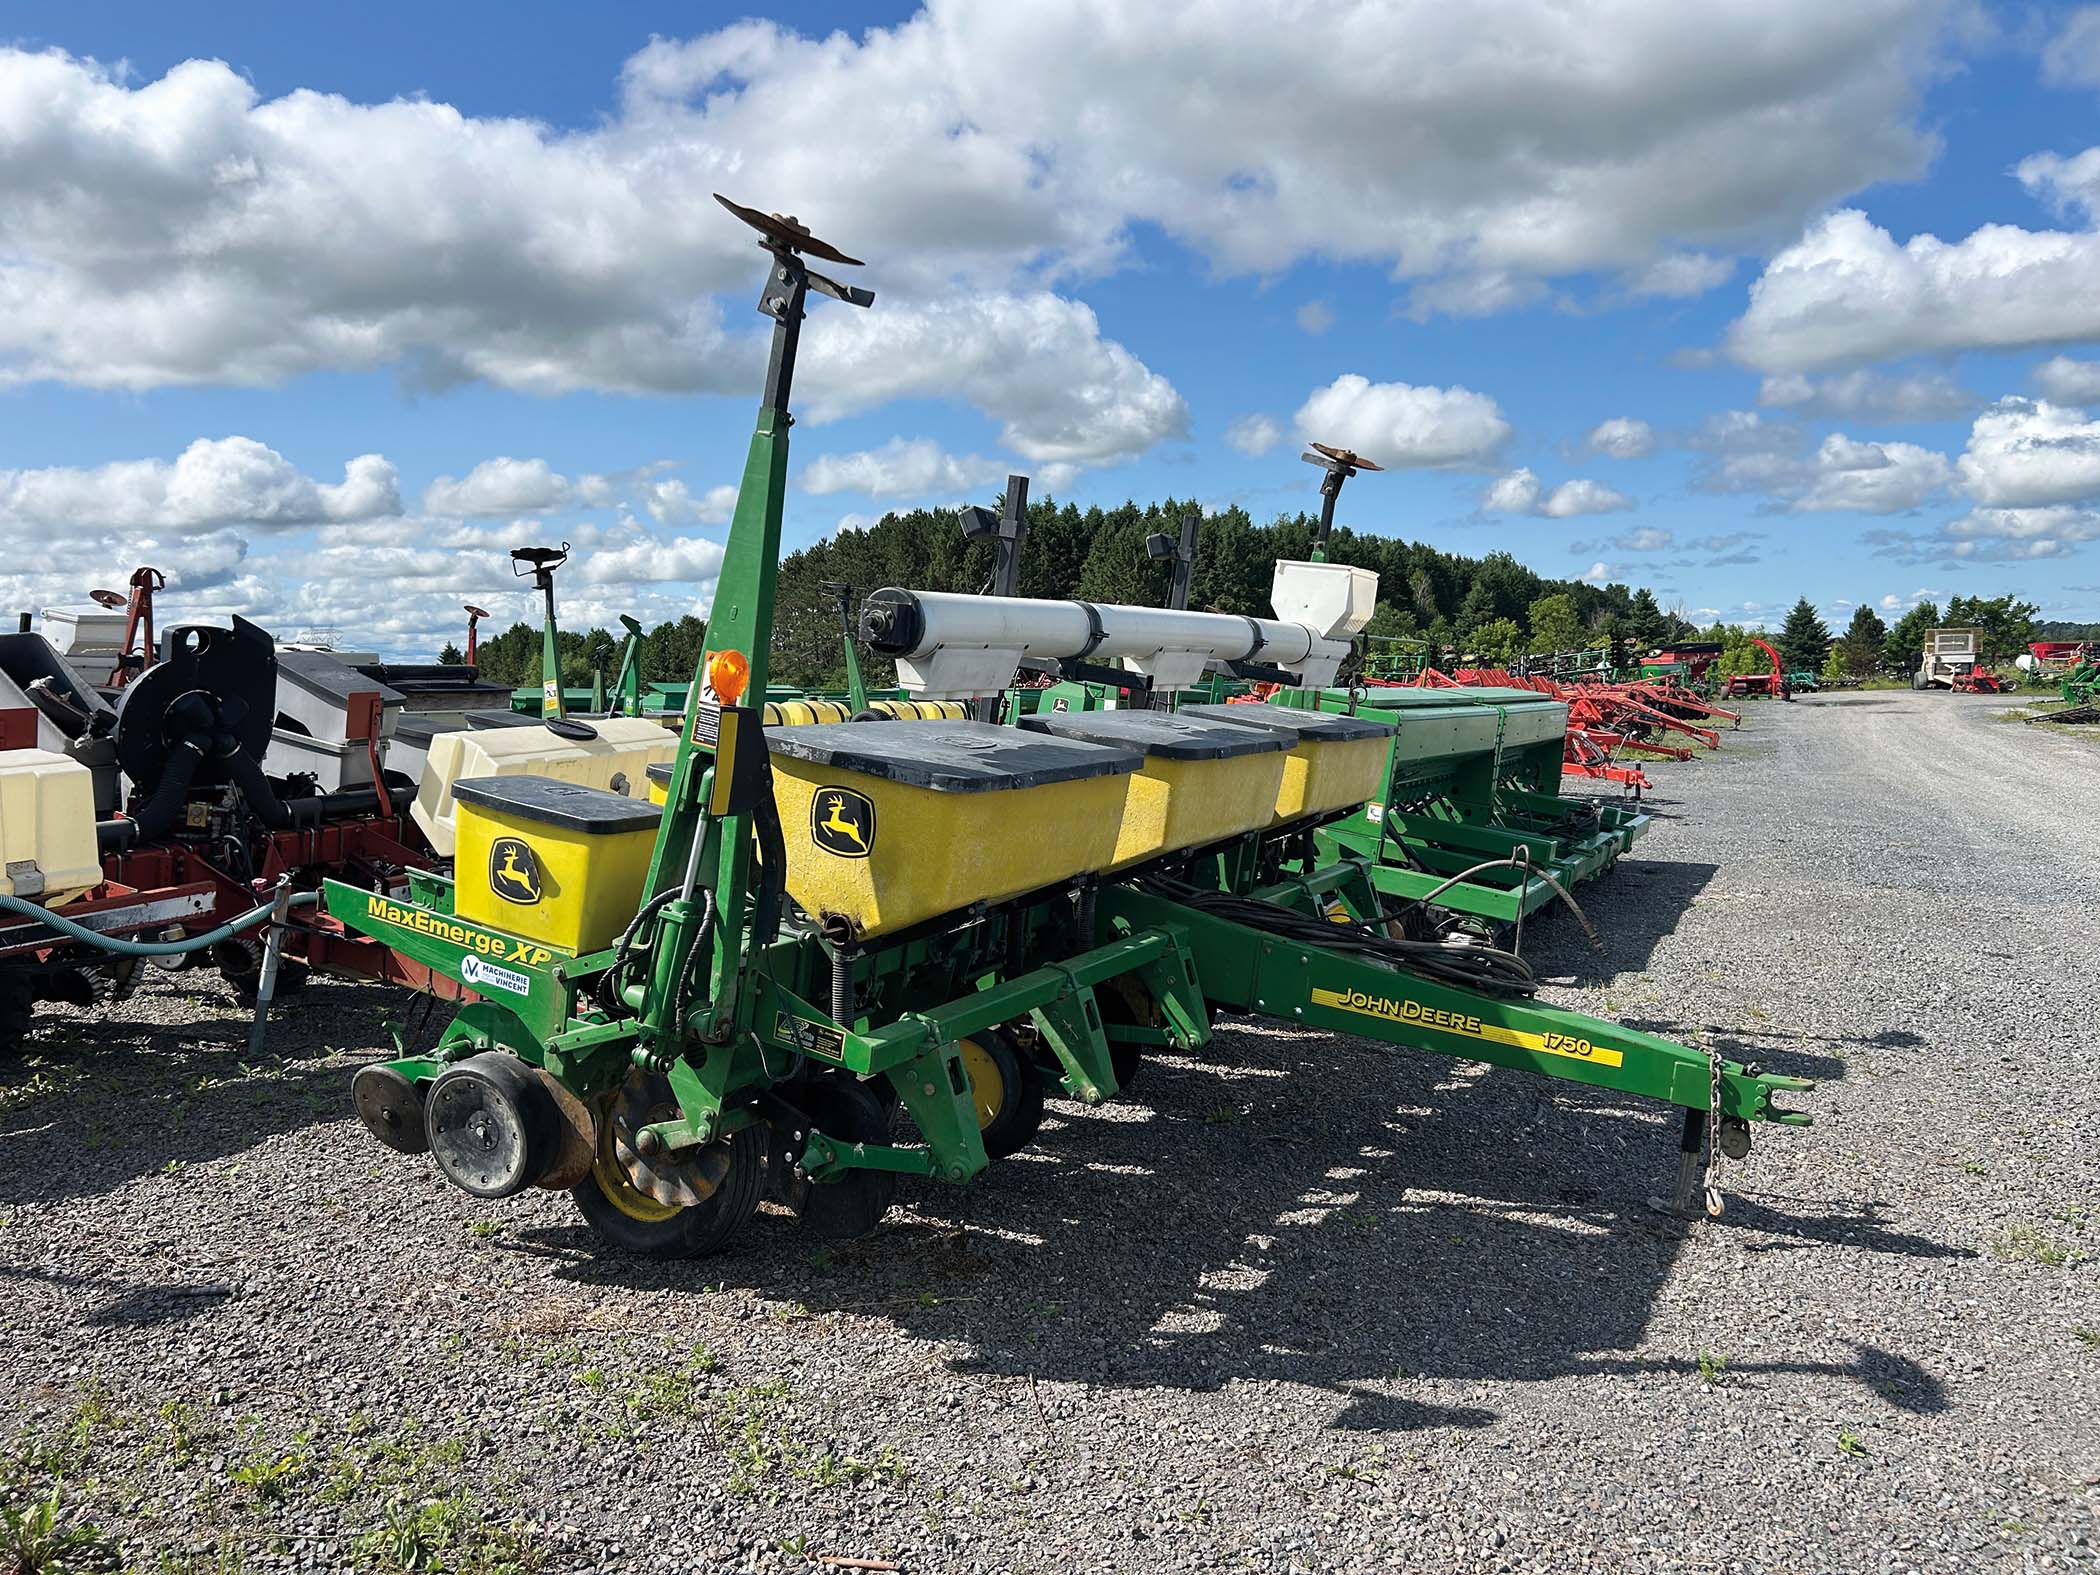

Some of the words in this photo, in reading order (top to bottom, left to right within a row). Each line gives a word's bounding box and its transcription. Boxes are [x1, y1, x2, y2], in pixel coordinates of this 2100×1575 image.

[368, 896, 506, 954] MaxEmerge
[504, 942, 552, 967] XP
[482, 964, 528, 986] MACHINERIE
[495, 976, 527, 993] VINCENT
[1337, 988, 1399, 1016] JOHN
[1402, 999, 1482, 1034] DEERE
[1541, 1031, 1593, 1056] 1750
